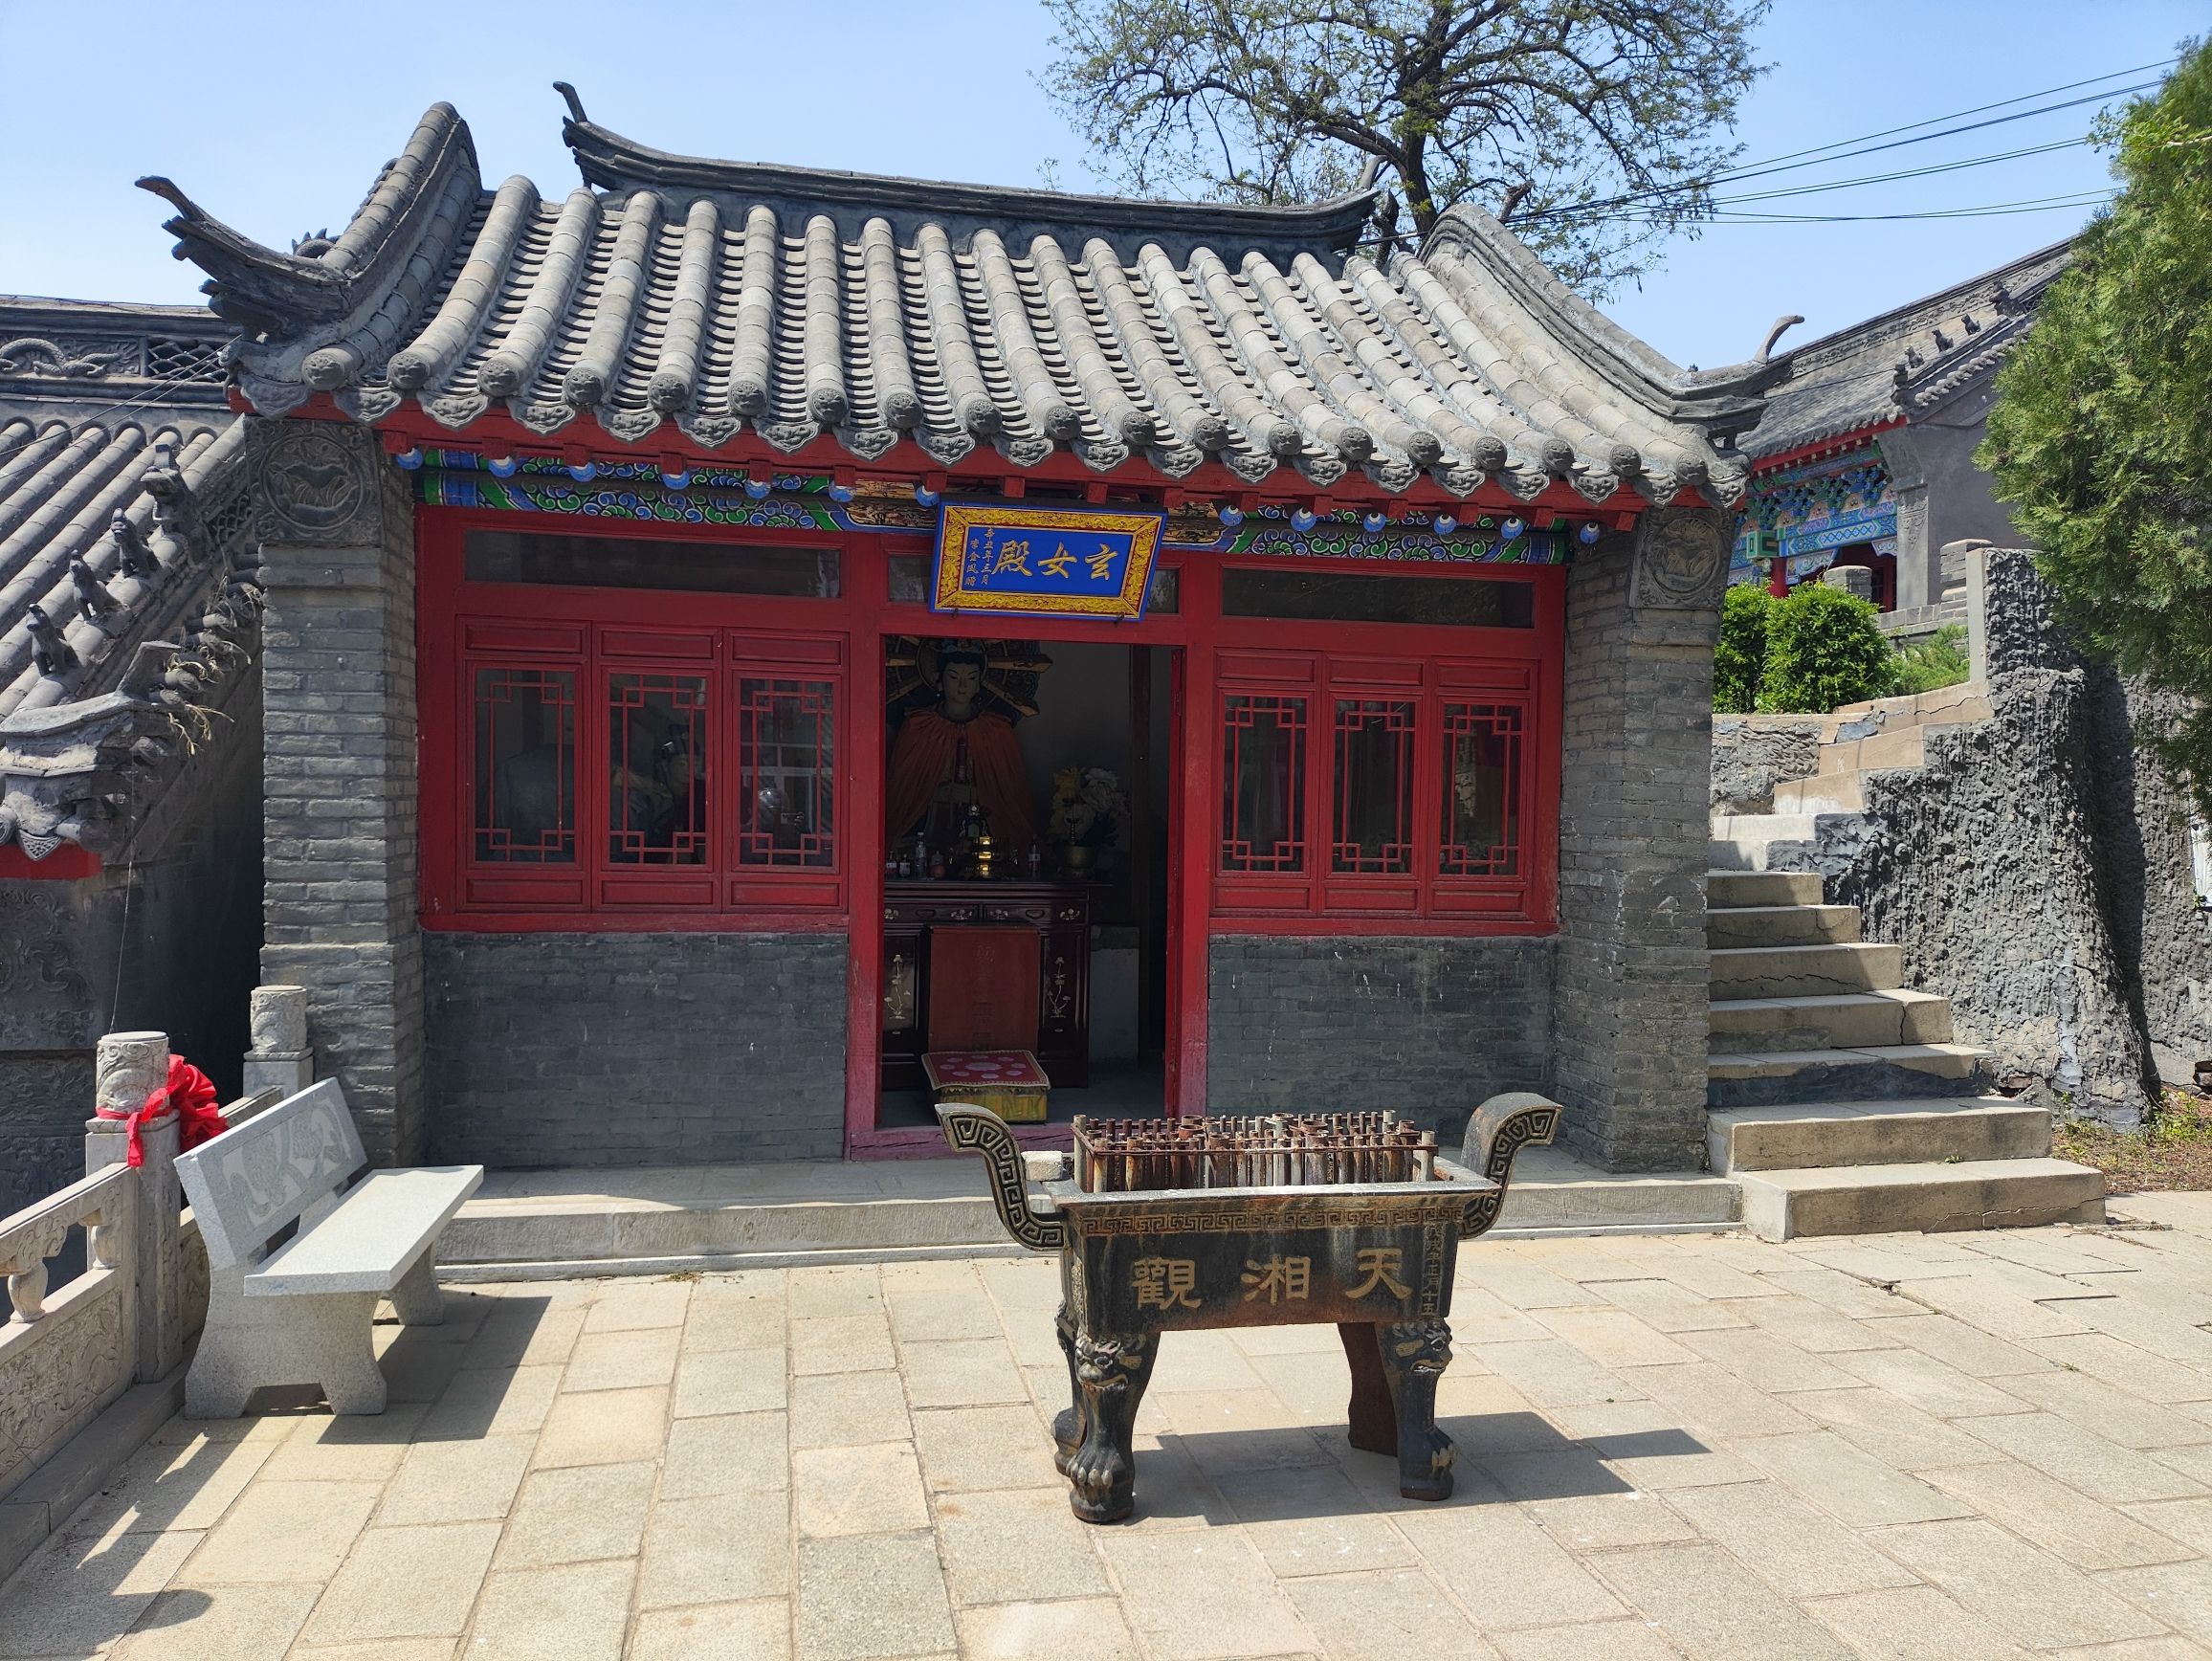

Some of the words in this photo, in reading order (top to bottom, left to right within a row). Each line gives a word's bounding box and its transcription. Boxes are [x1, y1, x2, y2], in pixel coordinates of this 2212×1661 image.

[992, 539, 1118, 581] 玄女殿
[1132, 1248, 1414, 1311] 天湘觀
